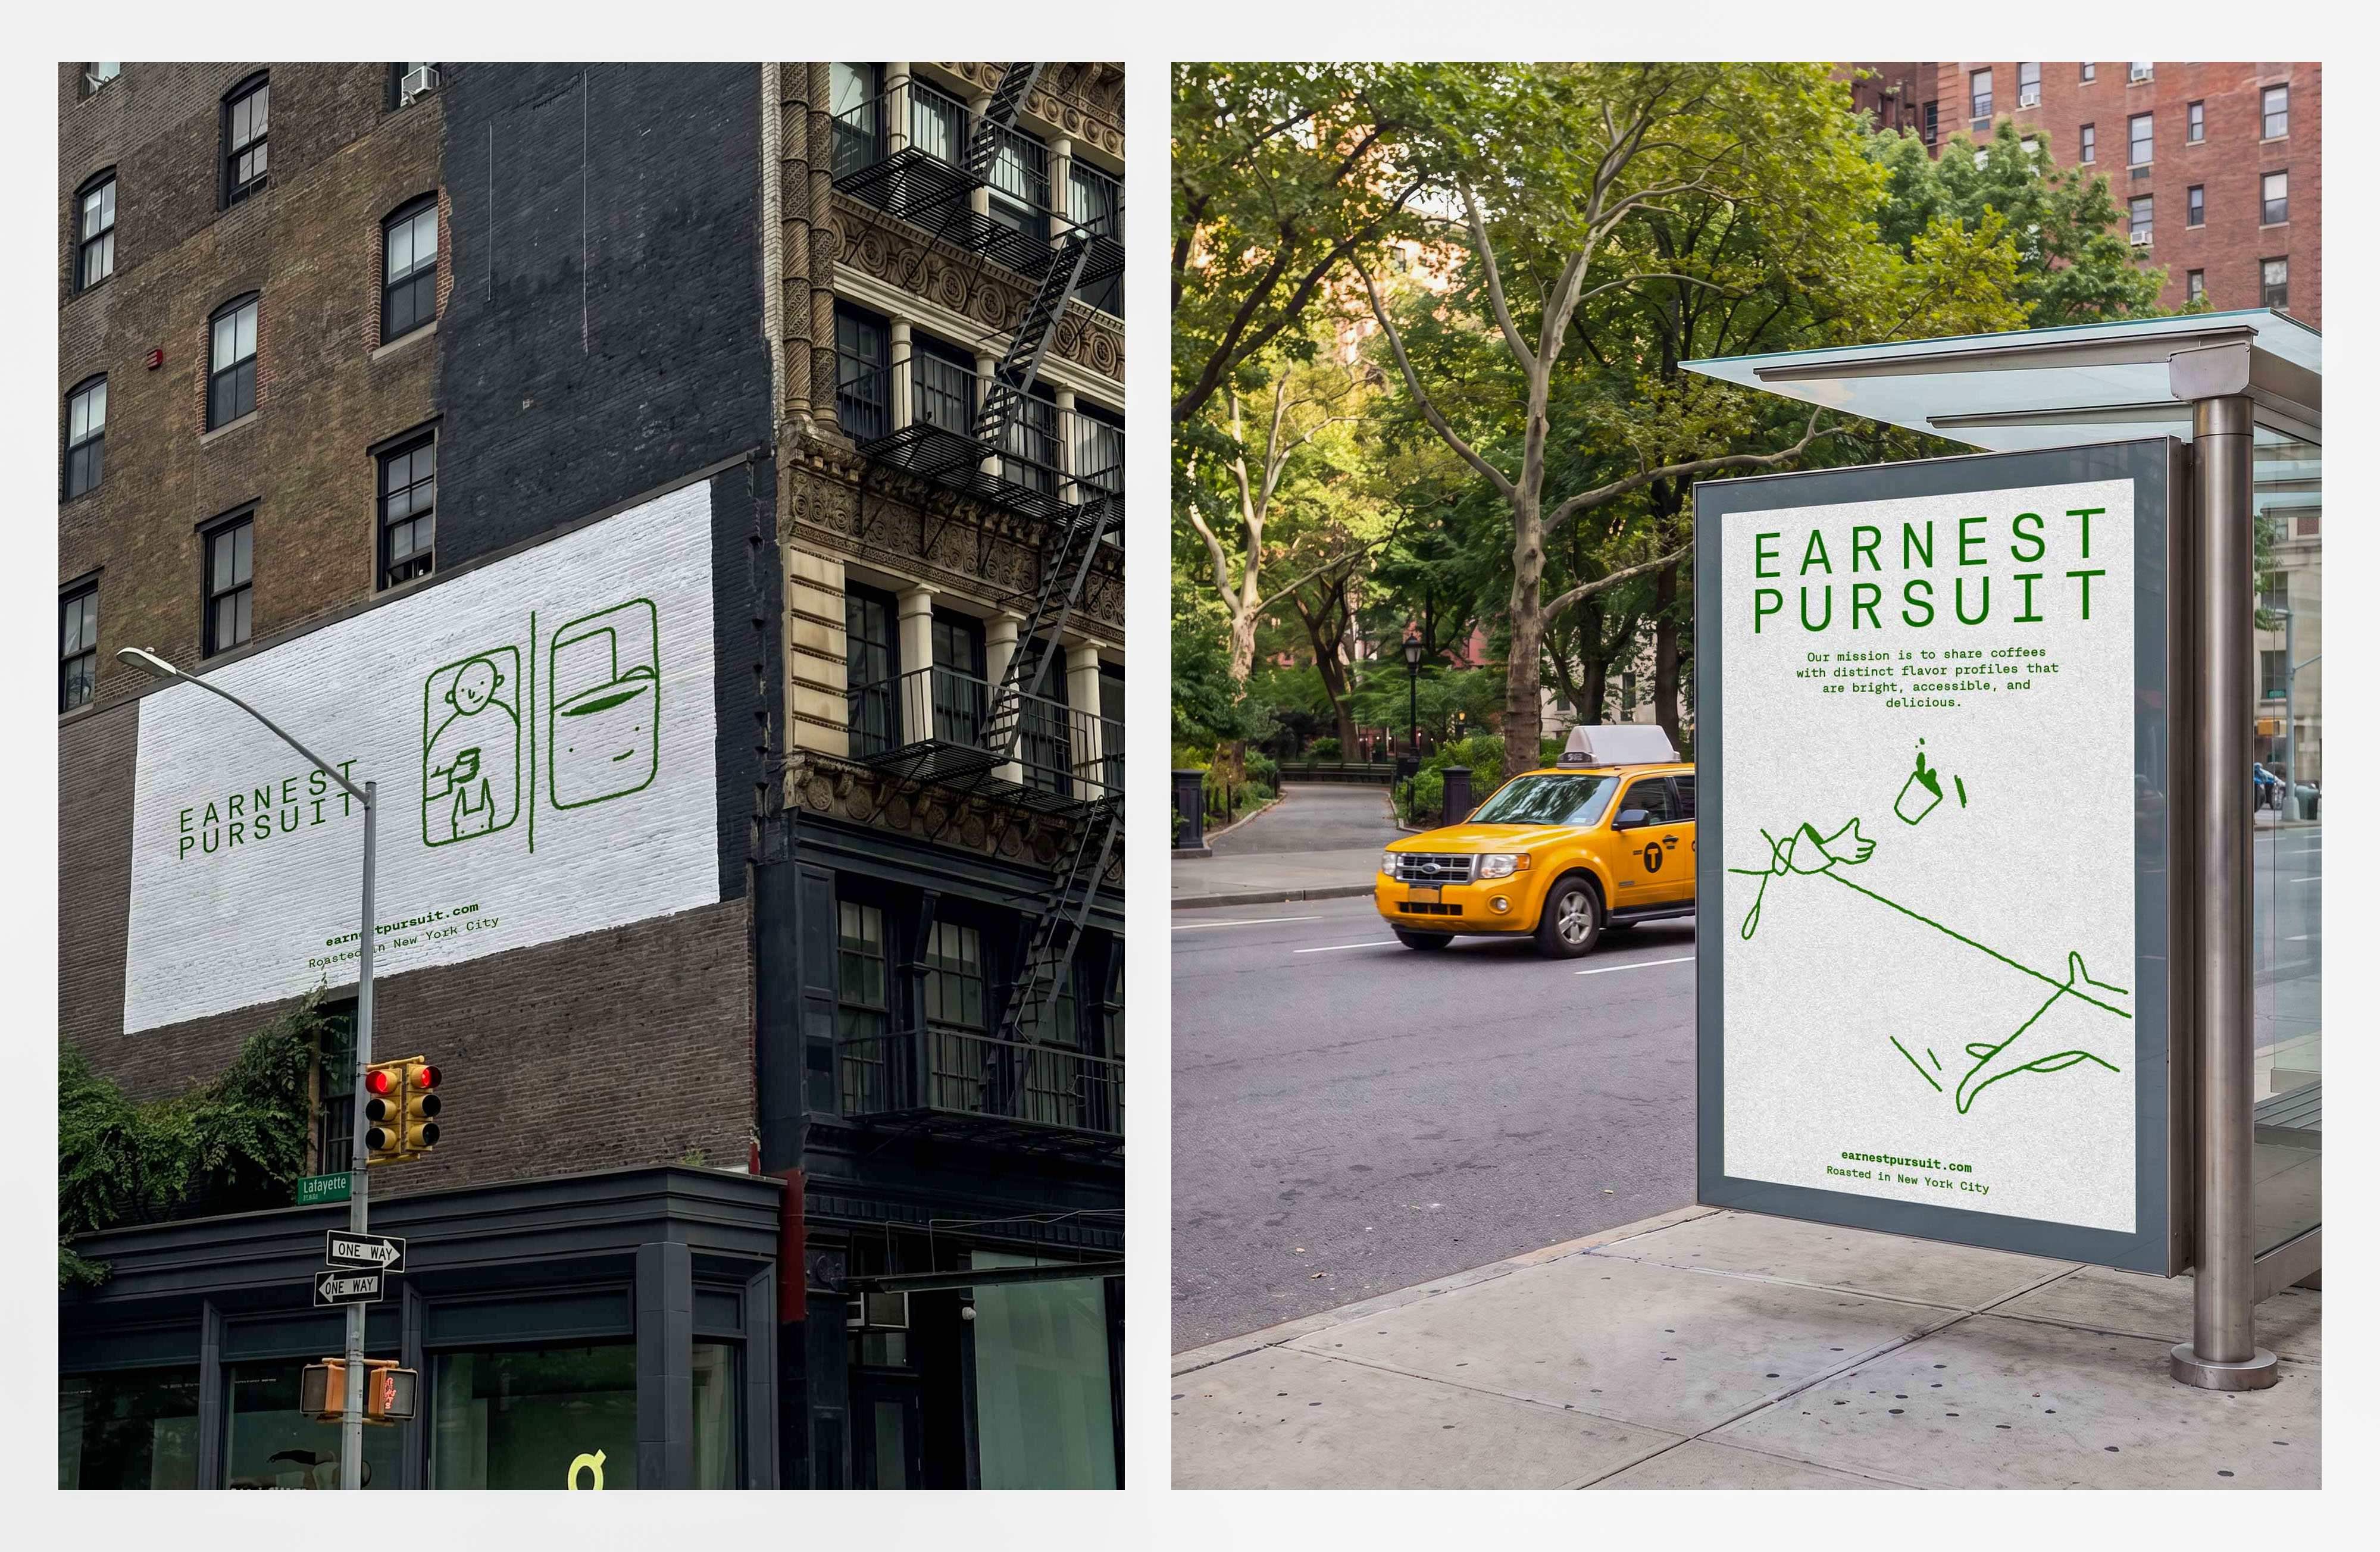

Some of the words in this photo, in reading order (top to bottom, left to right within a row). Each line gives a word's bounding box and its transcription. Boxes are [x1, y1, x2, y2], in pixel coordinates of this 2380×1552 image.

[1755, 507, 2107, 578] EARNEST
[1754, 569, 2107, 636] PURSUIT
[1807, 651, 1830, 663] Our
[1836, 651, 1890, 662] mission
[1898, 650, 1912, 661] is
[1921, 647, 1936, 660] to
[1944, 649, 1983, 659] share
[1990, 647, 2046, 658] coffees
[1796, 665, 1826, 678] with
[1833, 665, 1894, 677] distinct
[1902, 665, 1947, 677] flavor
[1955, 664, 2019, 677] profiles
[2026, 662, 2060, 674] that
[1823, 684, 1845, 694] are
[1852, 682, 1904, 695] bright,
[1912, 680, 1998, 692] accessible,
[2007, 680, 2031, 691] and
[1885, 697, 1962, 708] delicious.
[180, 759, 357, 834] EARNEST
[179, 791, 352, 861] PURSUIT
[1647, 848, 1659, 869] T
[326, 903, 479, 947] earntpursuit.com
[393, 937, 417, 948] New
[426, 926, 458, 940] York
[466, 917, 499, 932] City
[1841, 1151, 1973, 1174] earnestpursuit.com
[304, 1176, 346, 1195] Lafayette
[1827, 1165, 1871, 1179] Roasted
[1878, 1171, 1891, 1181] in
[1897, 1174, 1918, 1185] New
[1925, 1176, 1953, 1189] York
[1960, 1181, 1990, 1196] City
[338, 1243, 361, 1257] ONE
[371, 1246, 393, 1261] WAY
[325, 1281, 345, 1295] ONE
[353, 1278, 374, 1293] WAY
